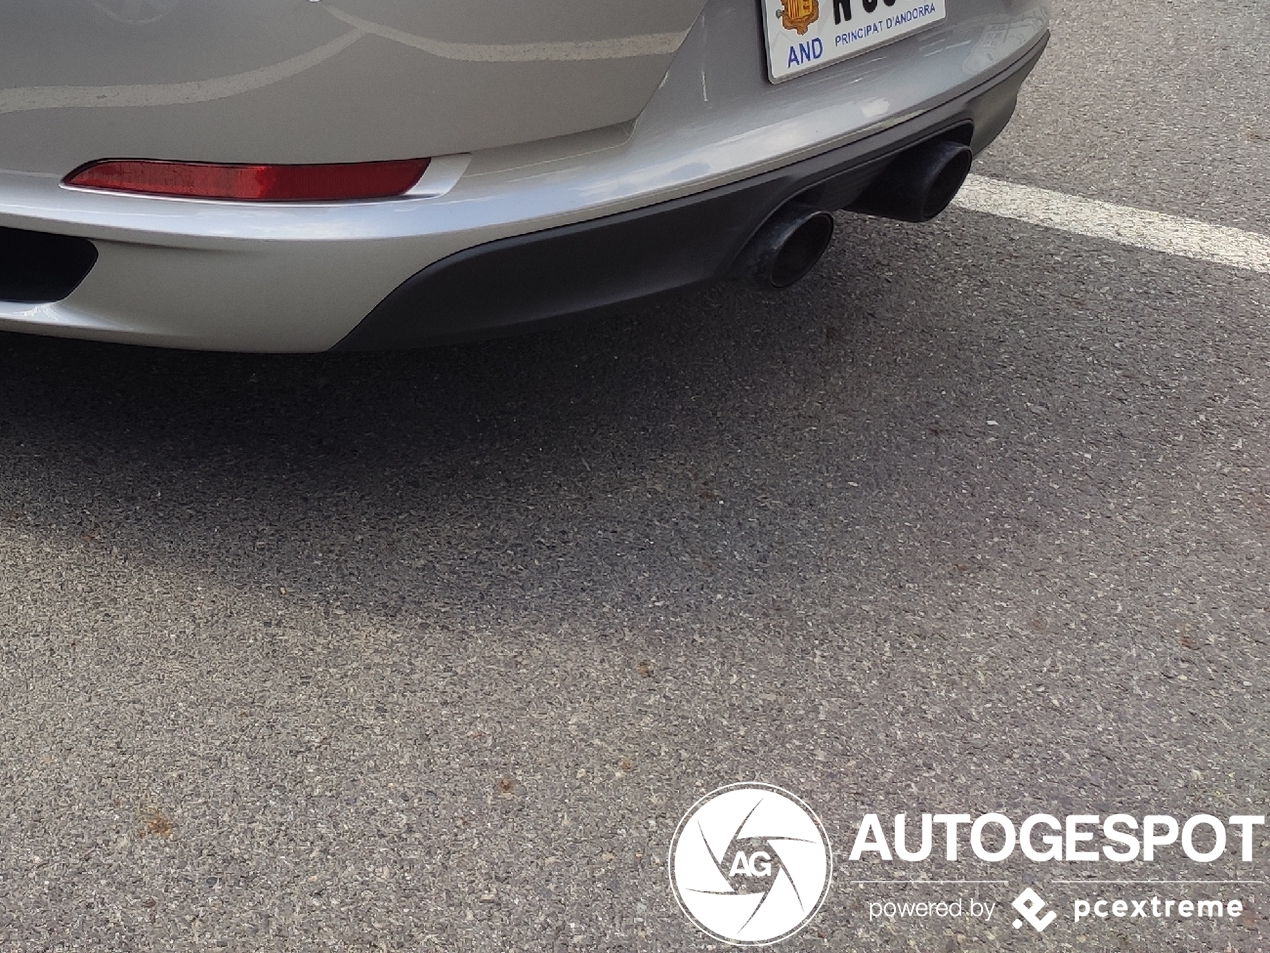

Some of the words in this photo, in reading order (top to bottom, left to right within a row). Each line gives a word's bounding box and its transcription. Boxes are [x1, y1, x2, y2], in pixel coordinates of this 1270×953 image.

[835, 20, 884, 47] PRINCIPAT
[886, 2, 936, 29] D'ANDORRA
[787, 37, 824, 69] AND
